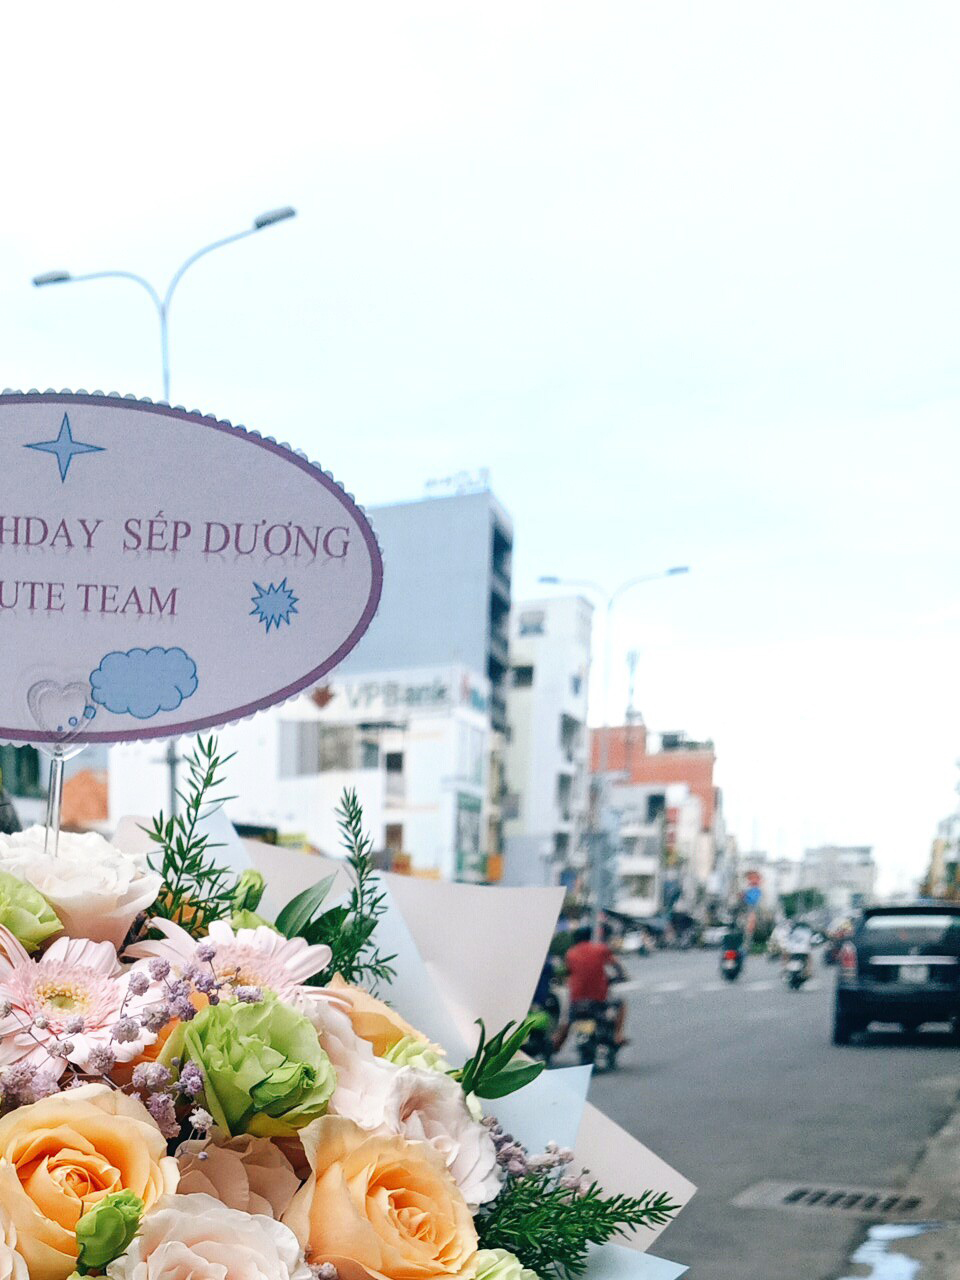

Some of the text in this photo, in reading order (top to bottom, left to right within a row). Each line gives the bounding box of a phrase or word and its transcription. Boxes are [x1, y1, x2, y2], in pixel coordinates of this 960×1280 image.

[123, 511, 191, 552] SẾP
[201, 519, 350, 558] DƯƠNG
[77, 583, 179, 615] TEAM
